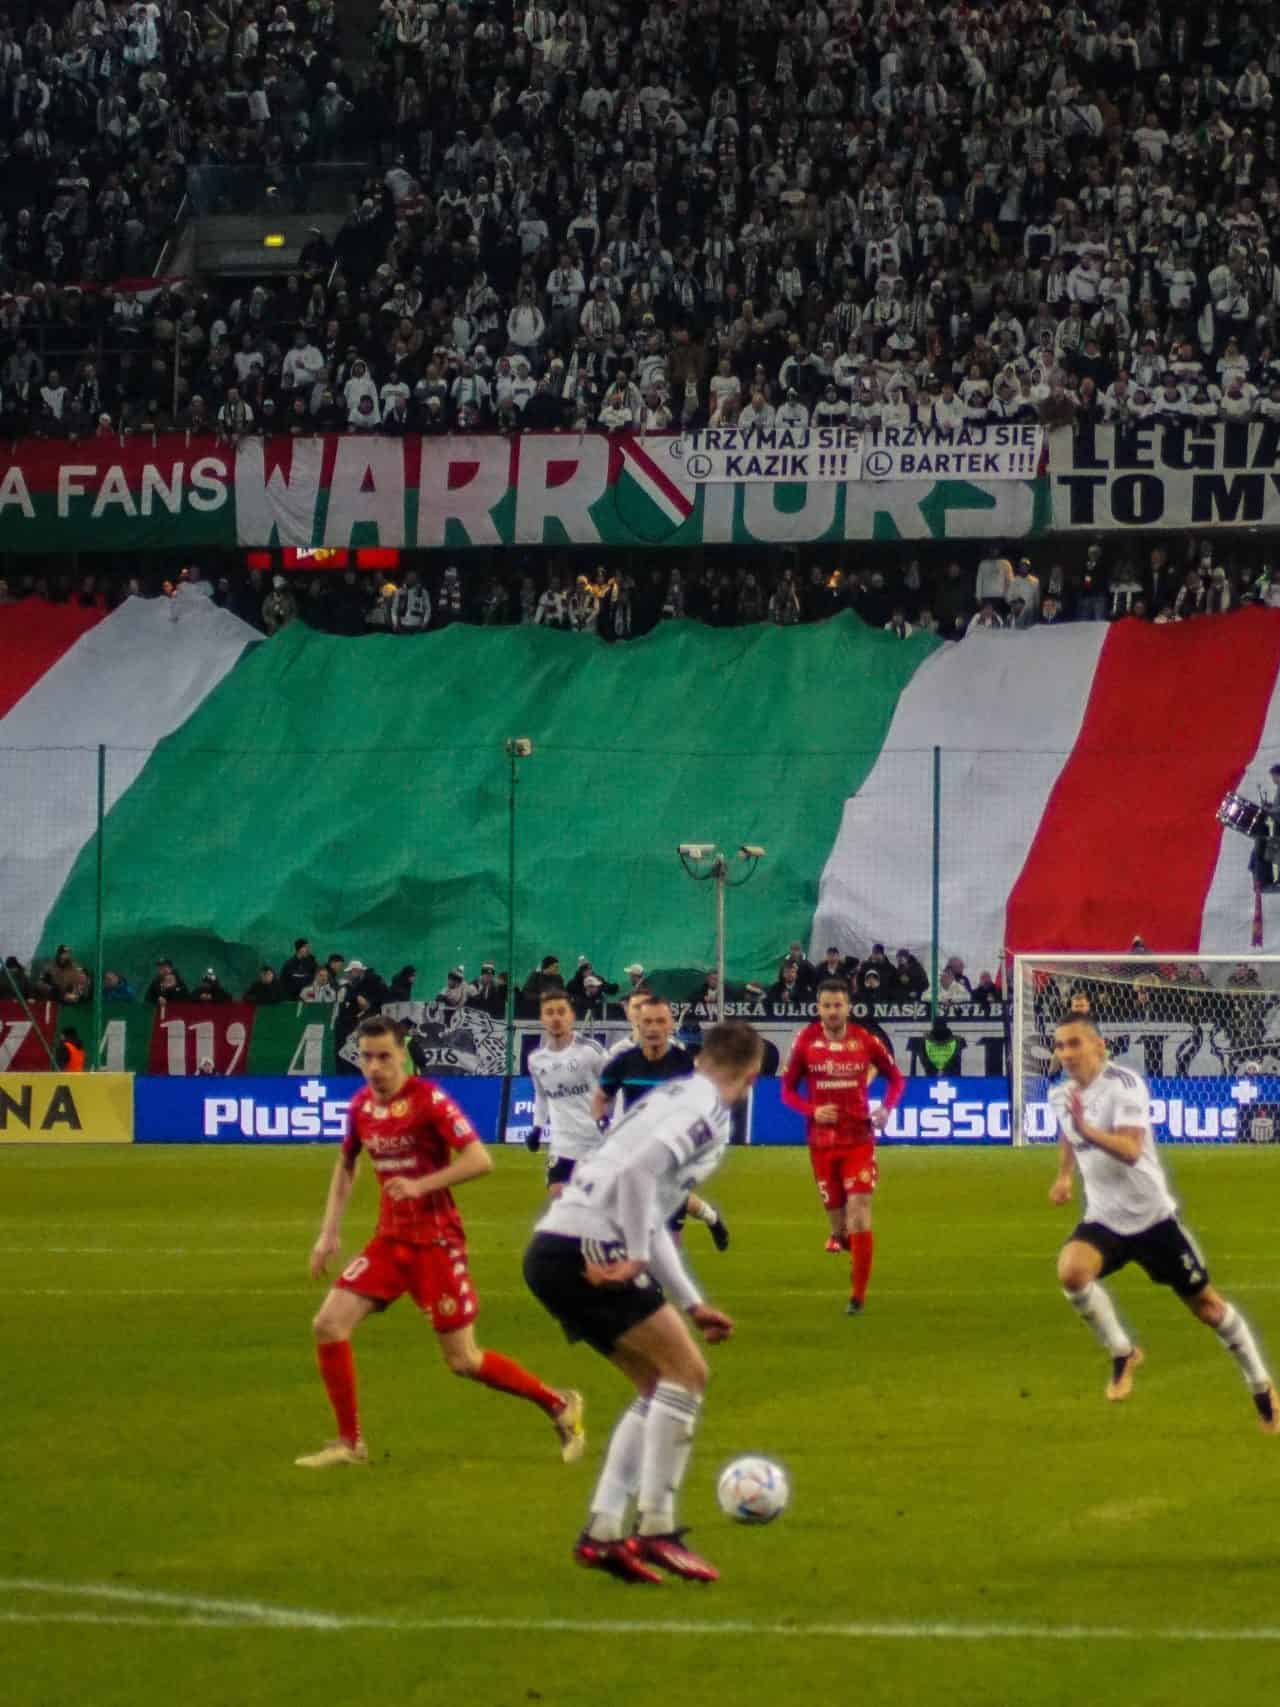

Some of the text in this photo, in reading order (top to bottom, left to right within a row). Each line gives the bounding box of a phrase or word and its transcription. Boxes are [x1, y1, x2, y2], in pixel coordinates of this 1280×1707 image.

[692, 430, 809, 453] TRZYMAJ
[869, 426, 990, 448] TRZYMAJ
[725, 456, 809, 476] KAZIK
[818, 455, 848, 476] !!!
[900, 453, 1000, 473] BARTEK
[1008, 451, 1036, 473] !!!
[58, 457, 230, 518] FANS
[1057, 474, 1166, 525] TO
